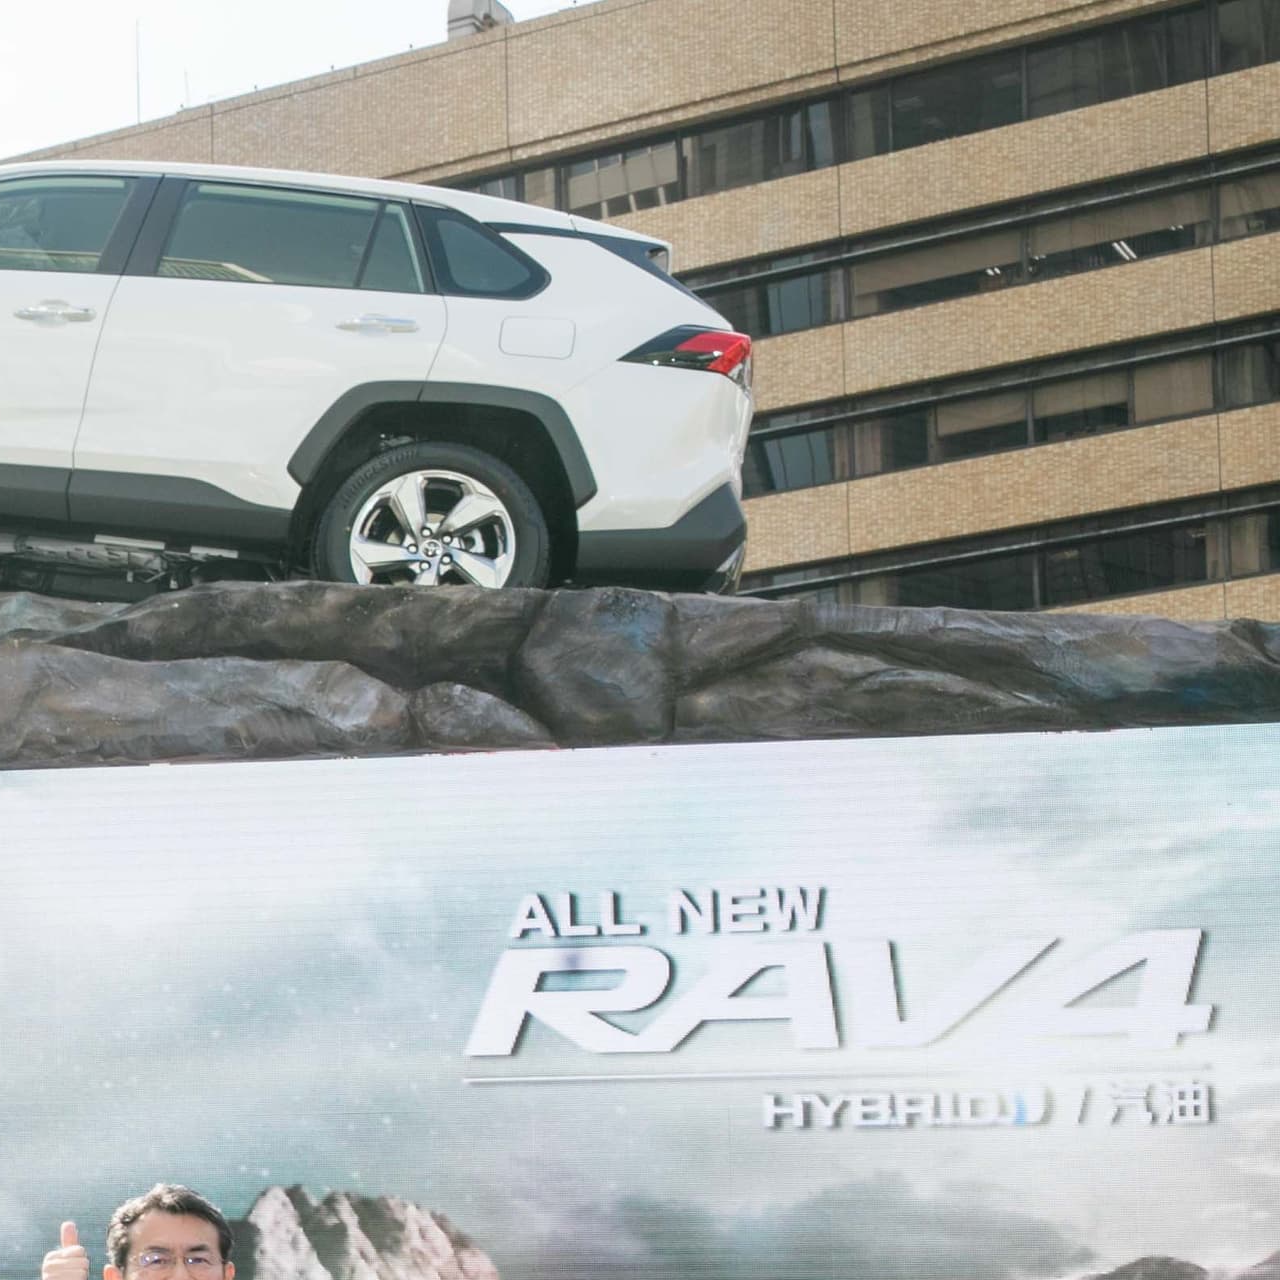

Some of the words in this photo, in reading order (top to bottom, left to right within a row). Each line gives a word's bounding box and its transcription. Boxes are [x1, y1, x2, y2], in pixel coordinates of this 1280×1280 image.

[509, 891, 644, 939] ALL
[668, 886, 829, 933] NEW
[463, 927, 1214, 1057] RAV4
